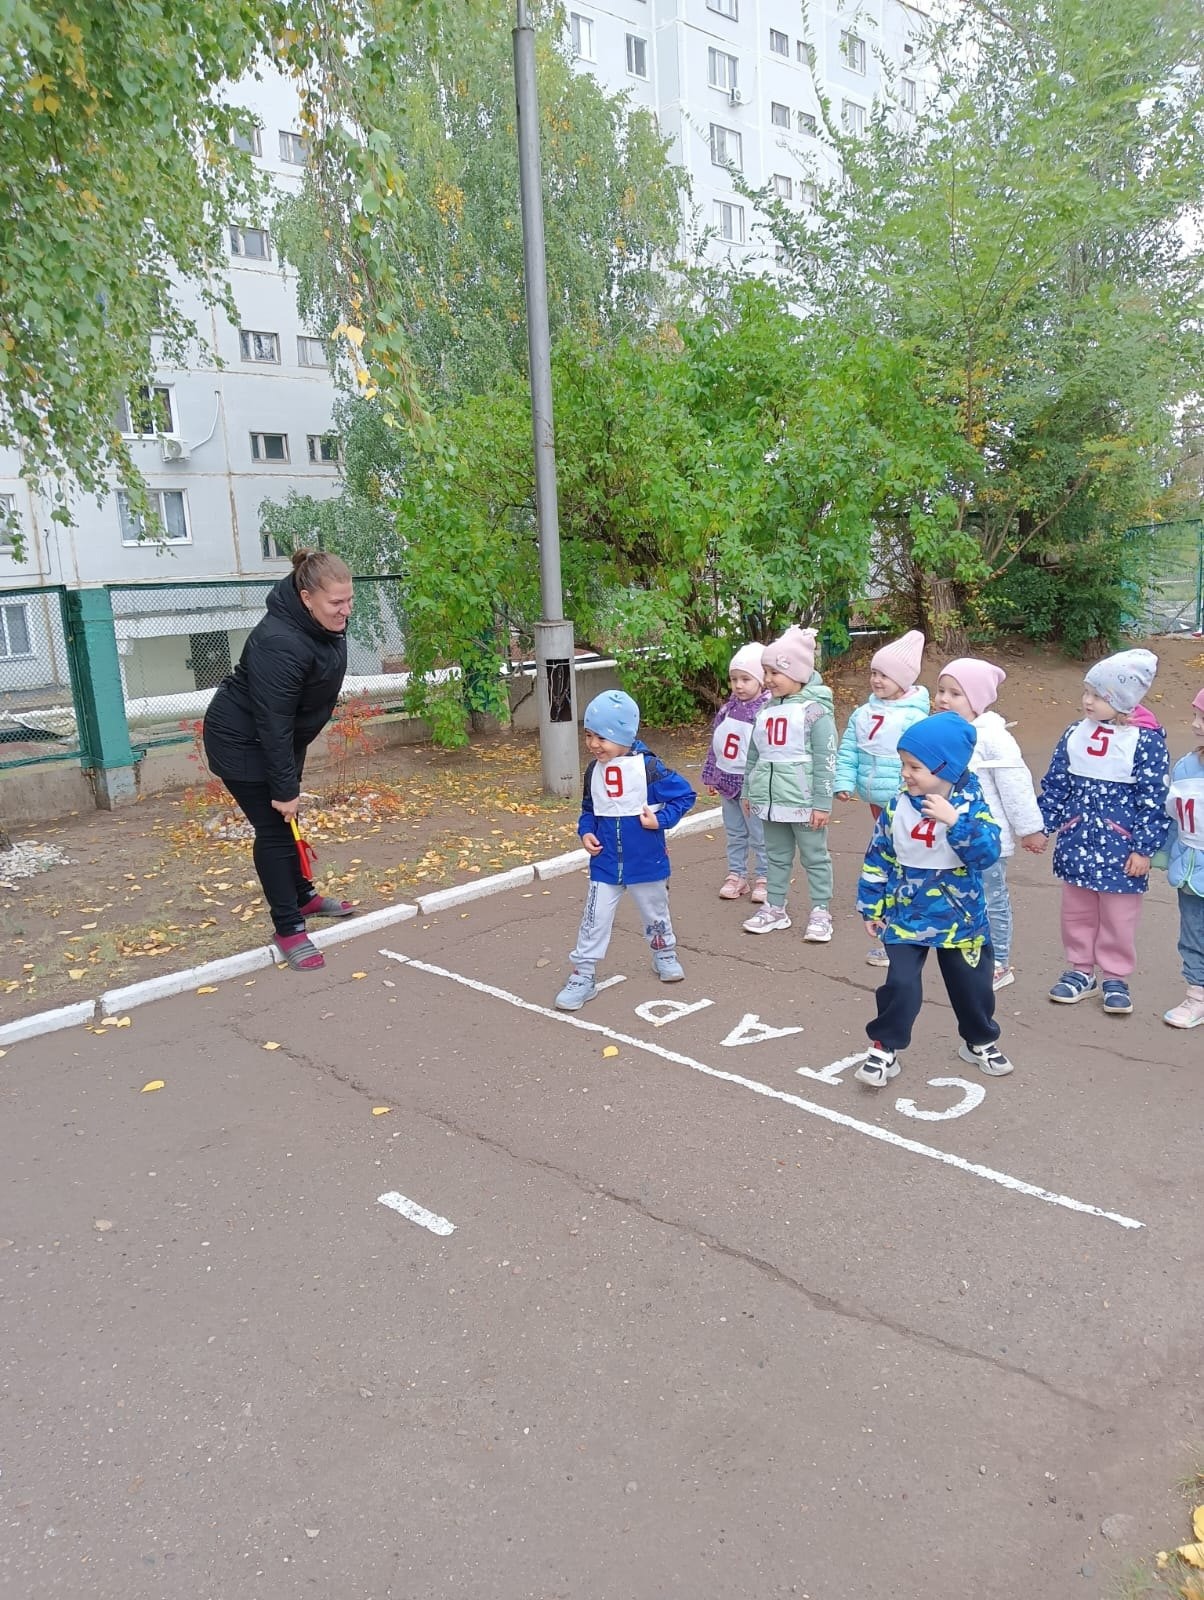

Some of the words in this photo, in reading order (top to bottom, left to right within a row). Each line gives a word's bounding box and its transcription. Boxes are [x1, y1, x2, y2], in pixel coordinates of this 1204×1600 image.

[765, 717, 788, 746] 10
[868, 715, 885, 741] 7
[1086, 726, 1115, 757] 5
[723, 733, 741, 760] 6
[604, 765, 624, 798] 9
[1175, 797, 1196, 834] 11
[910, 818, 937, 849] 4
